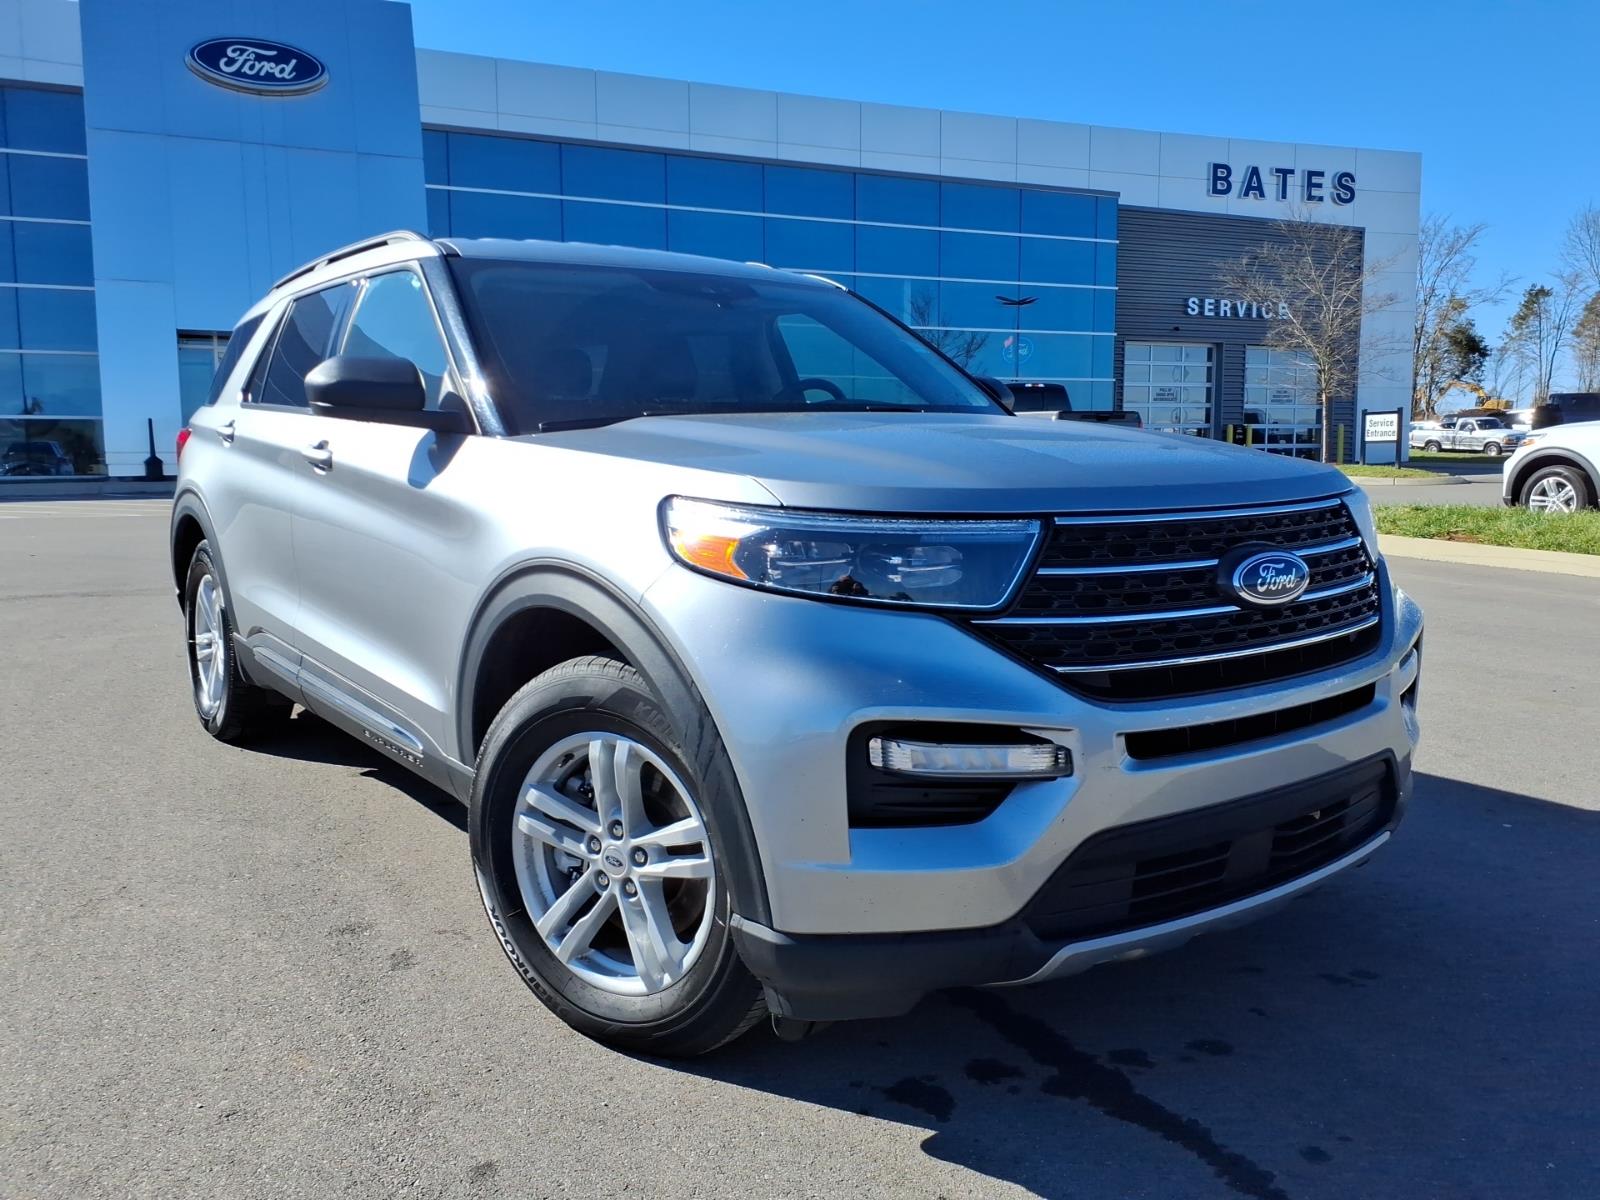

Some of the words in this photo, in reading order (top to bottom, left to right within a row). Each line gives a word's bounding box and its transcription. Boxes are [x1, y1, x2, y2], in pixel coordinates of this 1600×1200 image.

[219, 45, 297, 79] Ford
[1209, 162, 1356, 205] BATES
[1187, 297, 1289, 319] SERVICE
[1367, 429, 1396, 438] Entrance
[1369, 419, 1394, 428] Service
[1257, 563, 1300, 592] Ford
